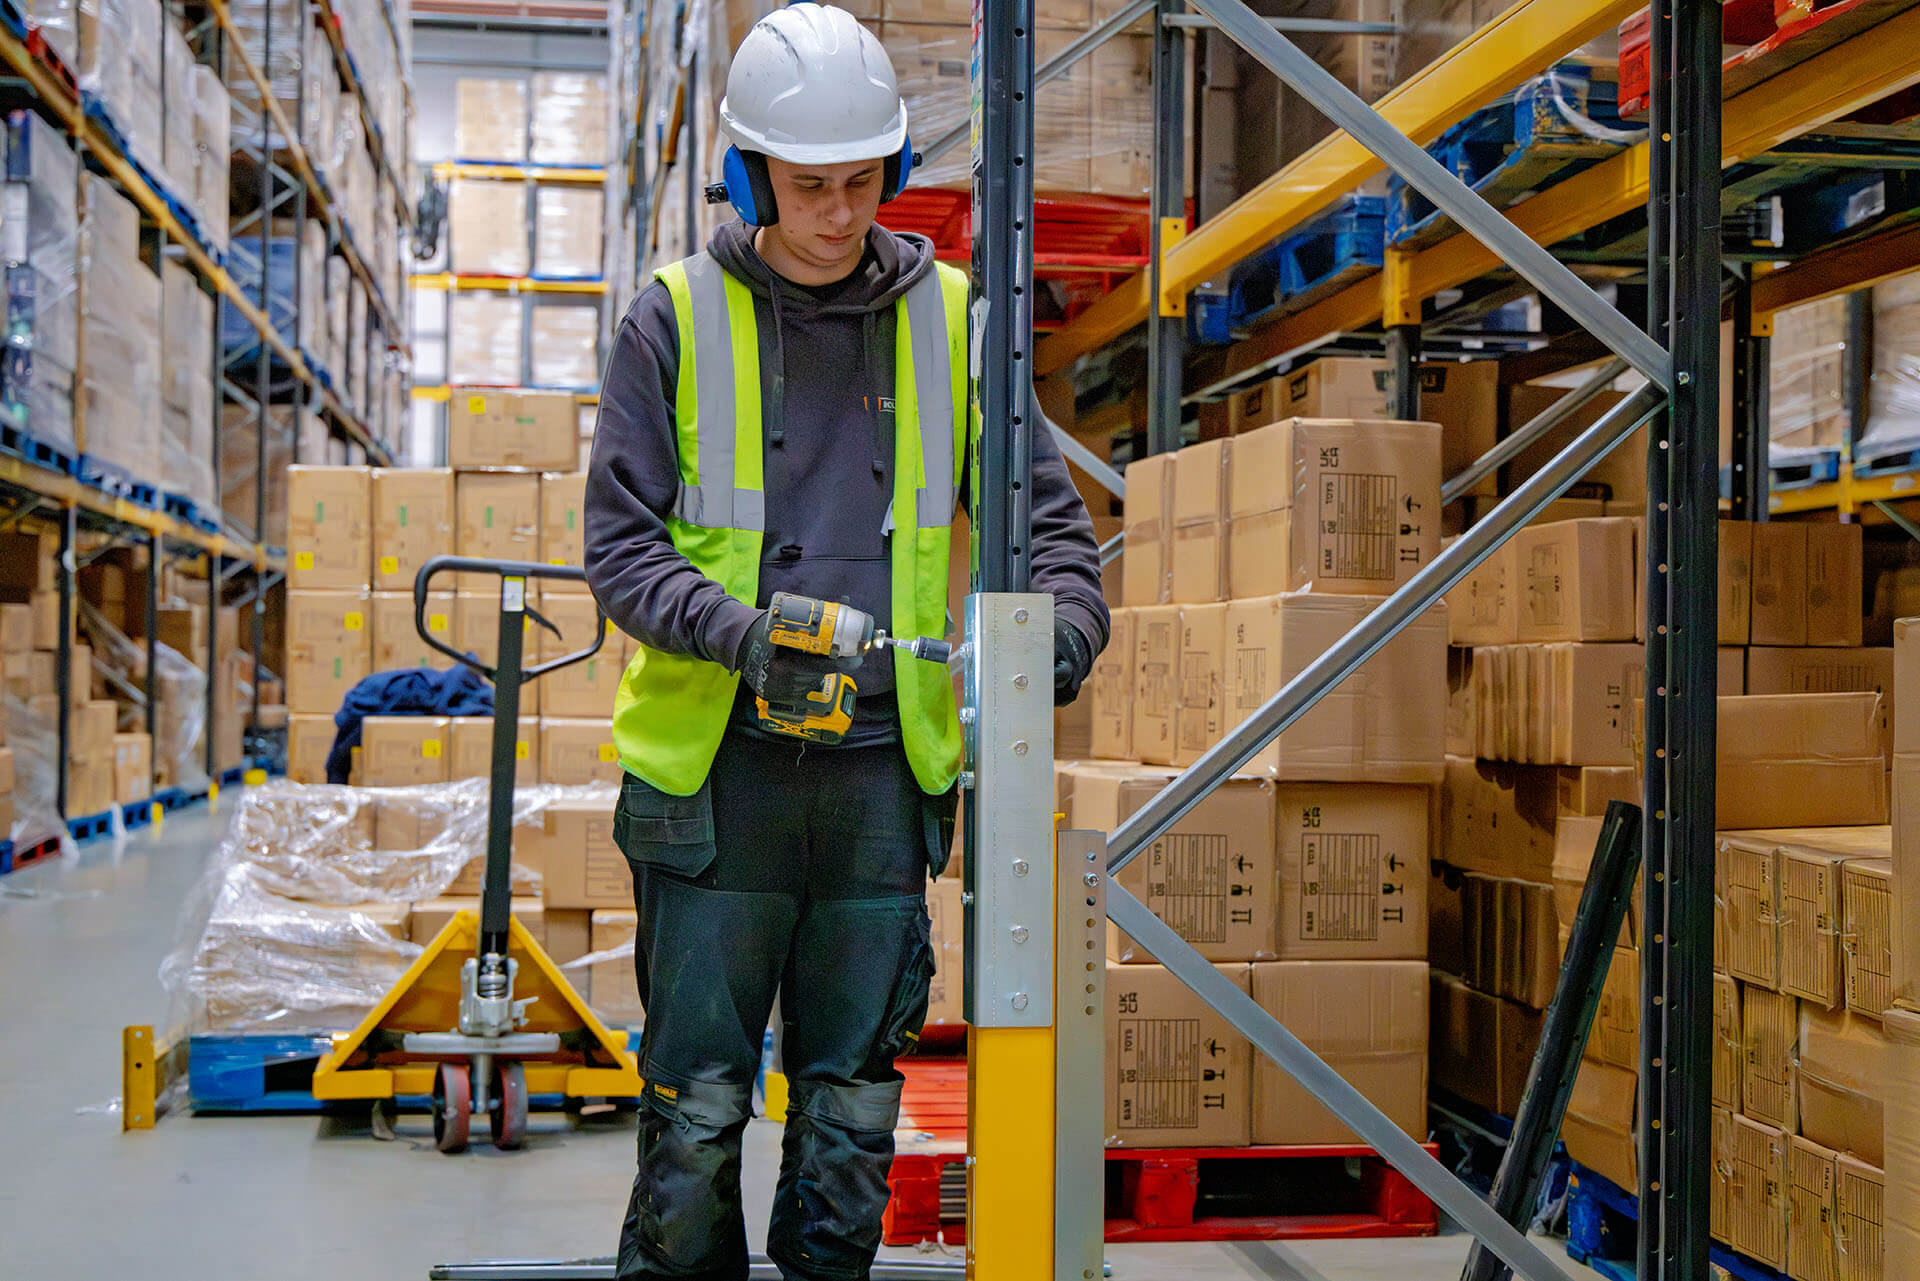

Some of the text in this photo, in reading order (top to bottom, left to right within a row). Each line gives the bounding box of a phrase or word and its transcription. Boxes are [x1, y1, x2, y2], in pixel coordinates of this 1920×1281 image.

[1319, 447, 1329, 468] UK
[1325, 482, 1333, 504] TOYS
[1302, 807, 1311, 828] UK
[1118, 993, 1128, 1014] UK
[1128, 992, 1138, 1014] CA
[1124, 1028, 1133, 1053] TOYS
